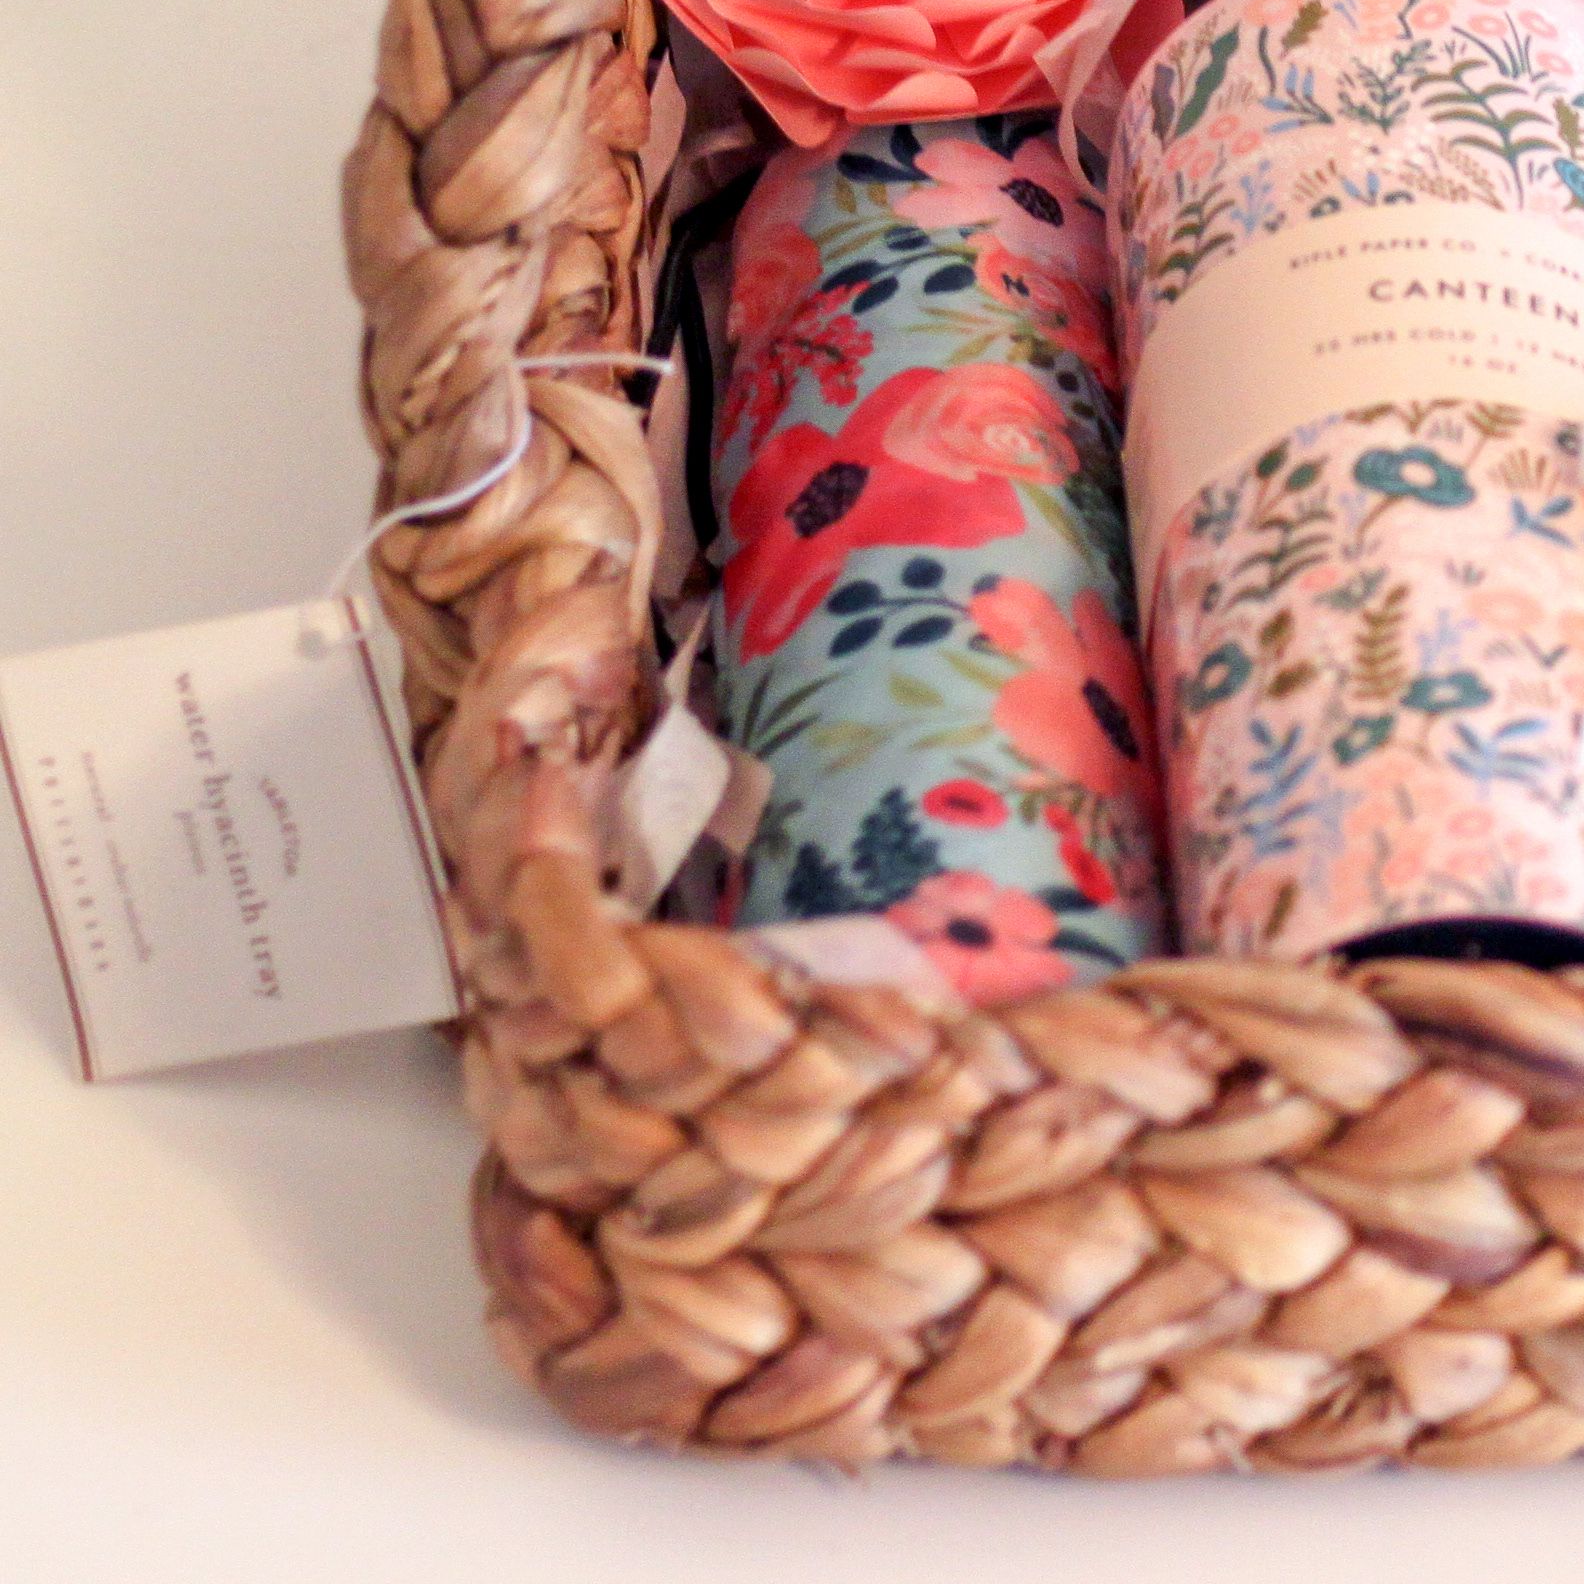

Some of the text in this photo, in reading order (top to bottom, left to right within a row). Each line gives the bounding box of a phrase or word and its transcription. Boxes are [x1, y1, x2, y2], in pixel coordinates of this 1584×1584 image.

[1365, 277, 1581, 330] CANTEEN
[174, 670, 215, 764] water
[199, 772, 268, 928] hyacinth
[248, 934, 282, 1002] tray
